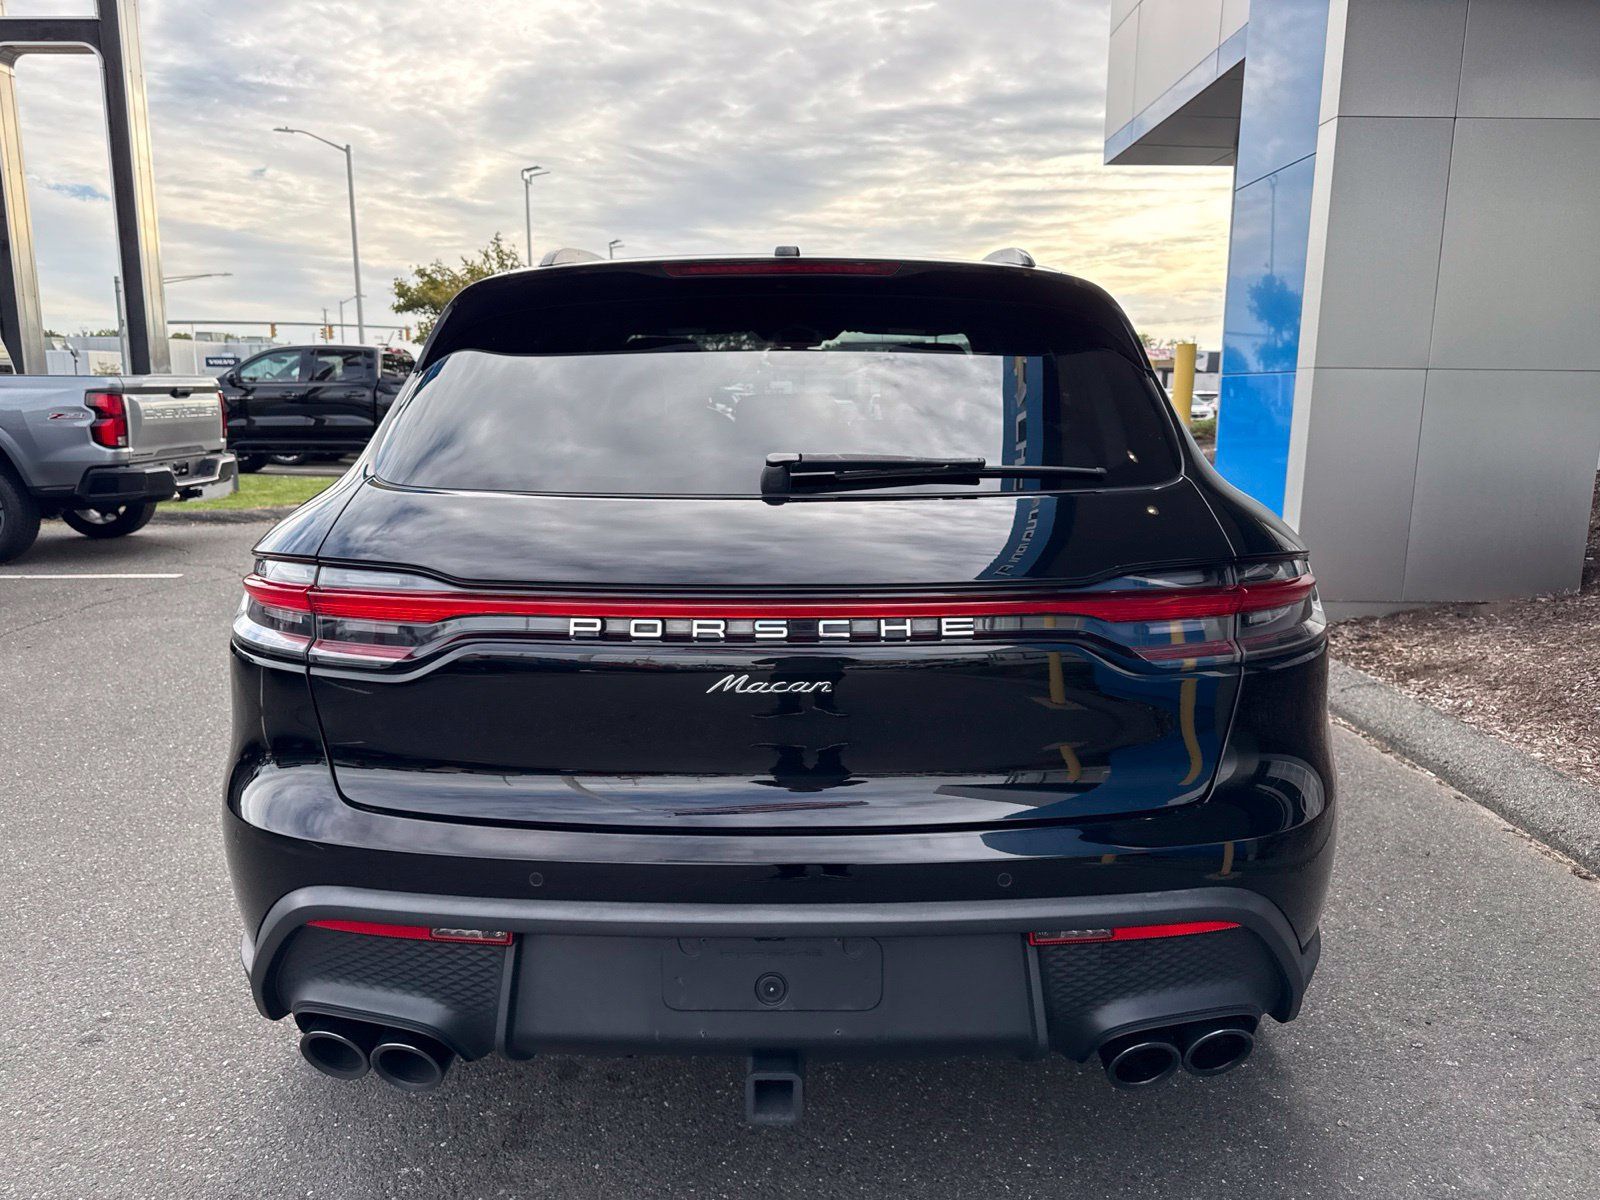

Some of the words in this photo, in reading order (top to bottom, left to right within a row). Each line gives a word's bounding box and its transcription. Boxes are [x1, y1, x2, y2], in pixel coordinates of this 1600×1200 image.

[144, 407, 219, 420] CHEVROLET
[569, 617, 975, 638] PORSCHE
[706, 674, 832, 694] Macan
